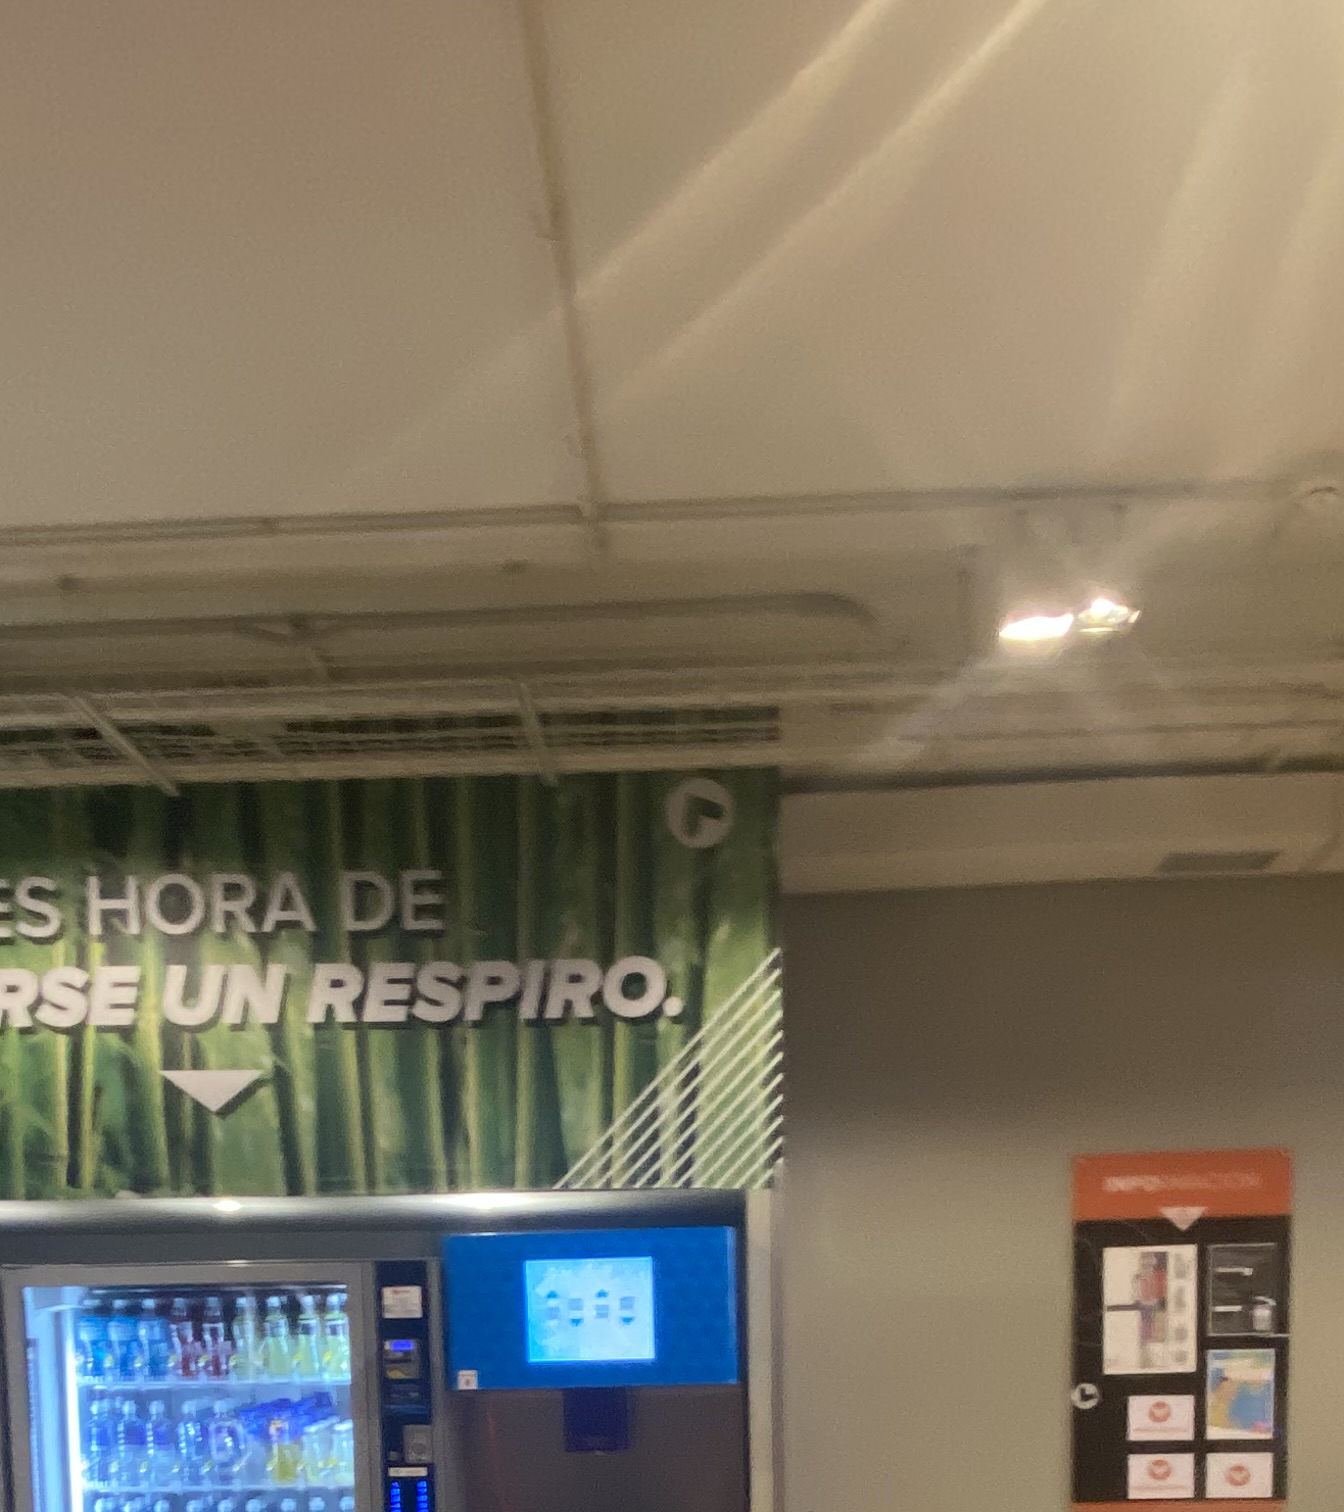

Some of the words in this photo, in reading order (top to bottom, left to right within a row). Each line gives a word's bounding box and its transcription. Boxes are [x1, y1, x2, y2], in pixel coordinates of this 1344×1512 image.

[86, 871, 316, 935] HORA
[342, 869, 448, 932] DE
[162, 964, 288, 1027] UN
[307, 955, 683, 1023] RESPIRO.
